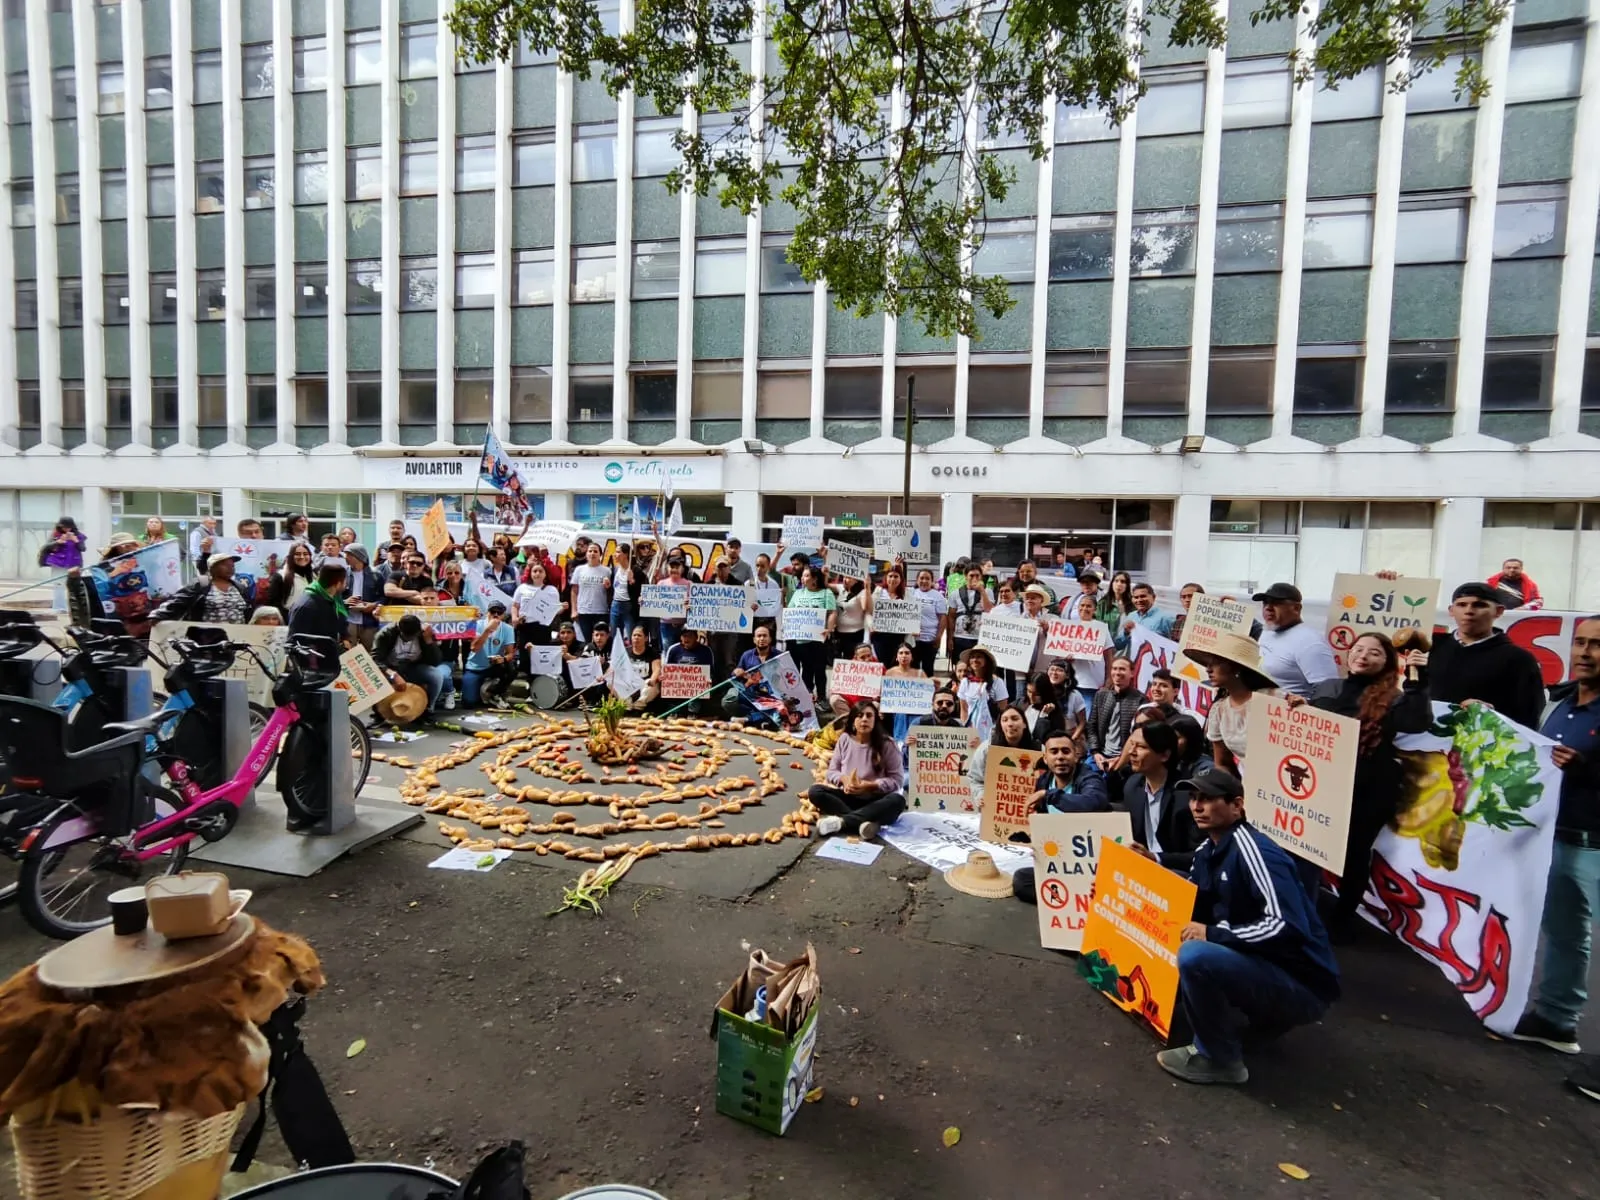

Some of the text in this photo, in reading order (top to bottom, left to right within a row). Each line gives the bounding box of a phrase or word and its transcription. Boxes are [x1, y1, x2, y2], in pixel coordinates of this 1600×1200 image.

[405, 462, 463, 475] AVOLARTUR
[524, 460, 579, 469] TURÍSTICO
[625, 459, 694, 477] FeelTrvels
[838, 552, 859, 568] SIN
[690, 585, 746, 599] CAJAMARCA
[874, 600, 919, 612] CAJAMARCA
[1369, 590, 1395, 613] SÍ
[1196, 604, 1244, 624] POPULARES
[1340, 612, 1422, 629] A LA VIDA
[430, 621, 468, 634] KING
[1049, 621, 1100, 641] ¡FUERA!
[1192, 624, 1218, 639] FUERA
[355, 653, 384, 690] EL TOLIMA
[883, 679, 894, 689] NO
[1267, 703, 1341, 737] LA TORTURA
[1270, 719, 1335, 749] NO ES ARTE
[916, 741, 967, 750] DE SAN JUAN
[1268, 733, 1333, 763] NI CULTURA
[916, 750, 942, 759] DICEN:
[919, 773, 960, 785] HOLCIM
[998, 773, 1035, 787] EL TOLI
[916, 784, 972, 797] Y ECOCIDAS!
[996, 783, 1033, 794] NO SE VE
[996, 792, 1027, 804] ¡MINE
[1256, 788, 1332, 827] EL TOLIMA DICE
[993, 815, 1012, 825] PARA
[1273, 807, 1305, 837] NO
[1071, 830, 1094, 858] SÍ
[1251, 818, 1329, 862] AL MALTRATO ANIMAL
[1046, 861, 1098, 876] A LA V
[1112, 870, 1170, 913] EL TOLIMA
[1075, 893, 1090, 913] N
[1117, 887, 1160, 921] DICE NO
[1050, 915, 1086, 930] A LA
[1101, 893, 1170, 944] A LA MINERIA
[1093, 902, 1178, 968] CONTAMINANTE
